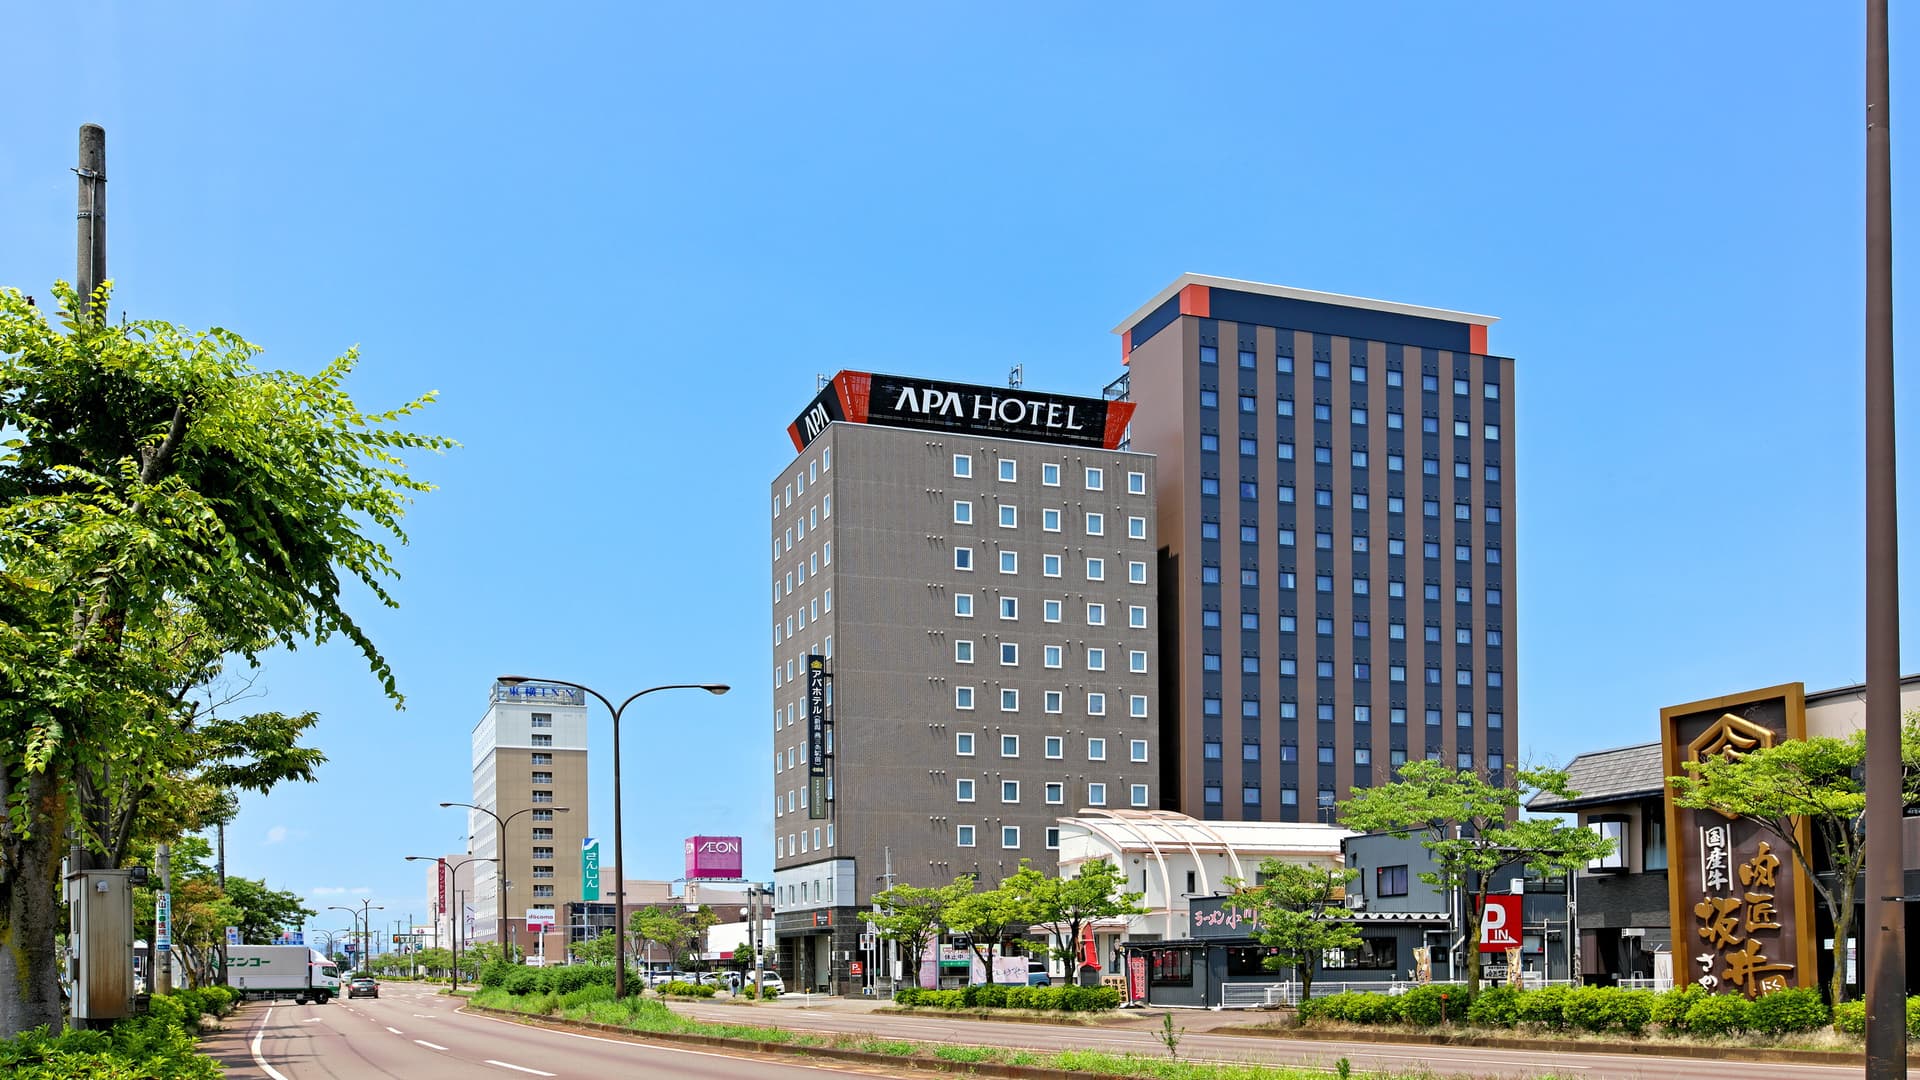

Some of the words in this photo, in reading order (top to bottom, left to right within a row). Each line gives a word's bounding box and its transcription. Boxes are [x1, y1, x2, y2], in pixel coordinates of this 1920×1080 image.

[804, 402, 830, 441] APA
[894, 386, 964, 418] APA
[972, 394, 1083, 430] HOTEL
[698, 842, 738, 853] AEON
[1705, 826, 1729, 891] 国産牛
[586, 852, 598, 888] さんしん
[1738, 841, 1782, 933] 肉匠
[1194, 910, 1225, 926] ラーメン
[1480, 903, 1506, 944] P
[1494, 929, 1509, 940] IN
[226, 957, 271, 967] センコー
[1696, 953, 1719, 997] さか
